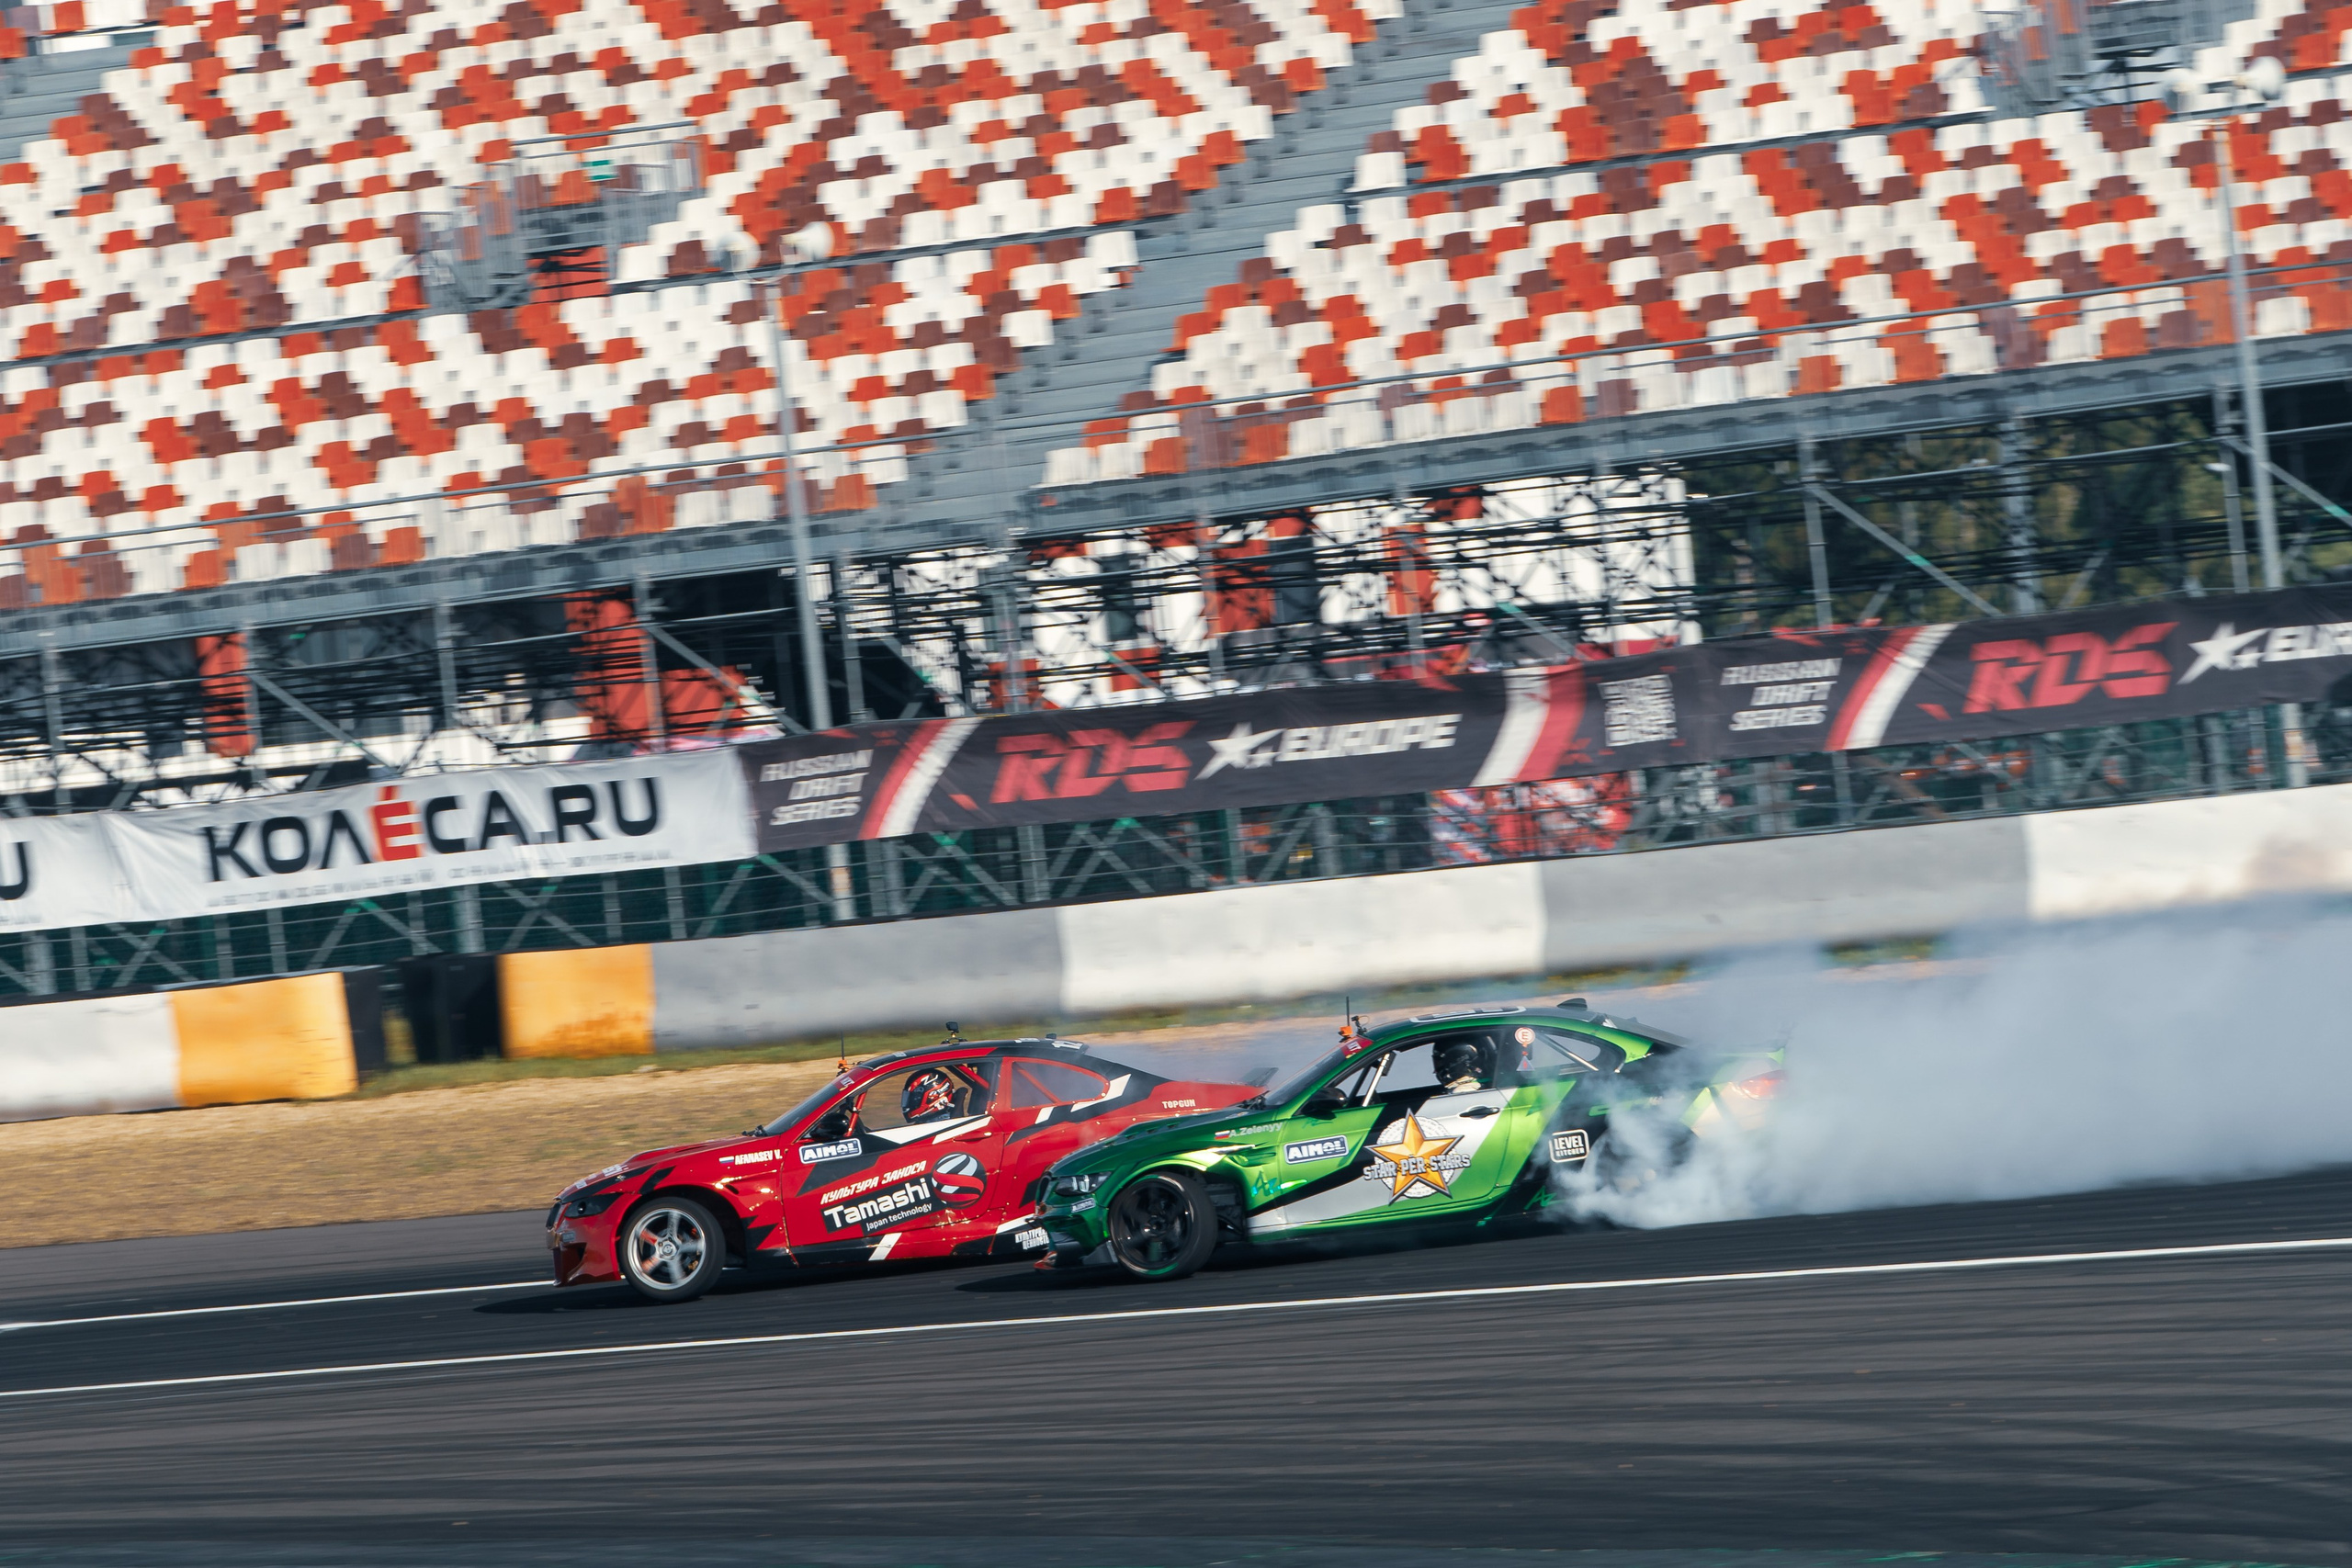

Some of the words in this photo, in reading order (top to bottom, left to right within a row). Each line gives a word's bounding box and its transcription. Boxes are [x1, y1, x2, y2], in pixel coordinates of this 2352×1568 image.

[1962, 622, 2180, 714] RDS
[1750, 681, 1838, 706] DRIFT
[1729, 705, 1828, 731] SERIES
[1276, 714, 1463, 761] EUROPE
[989, 720, 1197, 804] RDS
[769, 795, 863, 826] SERIES
[1162, 1100, 1196, 1110] TOPGUN
[803, 1142, 860, 1161] AIMOL
[1288, 1140, 1345, 1160] AIMOL
[1554, 1135, 1584, 1150] LEVEL
[735, 1150, 774, 1166] AFANASEV
[1363, 1161, 1397, 1180] STAR
[1430, 1154, 1471, 1171] STARS
[820, 1177, 879, 1205] КУЛЬТУРА
[881, 1160, 927, 1185] ЗАНОСА
[823, 1178, 931, 1228] Tamashi
[866, 1217, 888, 1232] Japan
[889, 1203, 933, 1224] technology
